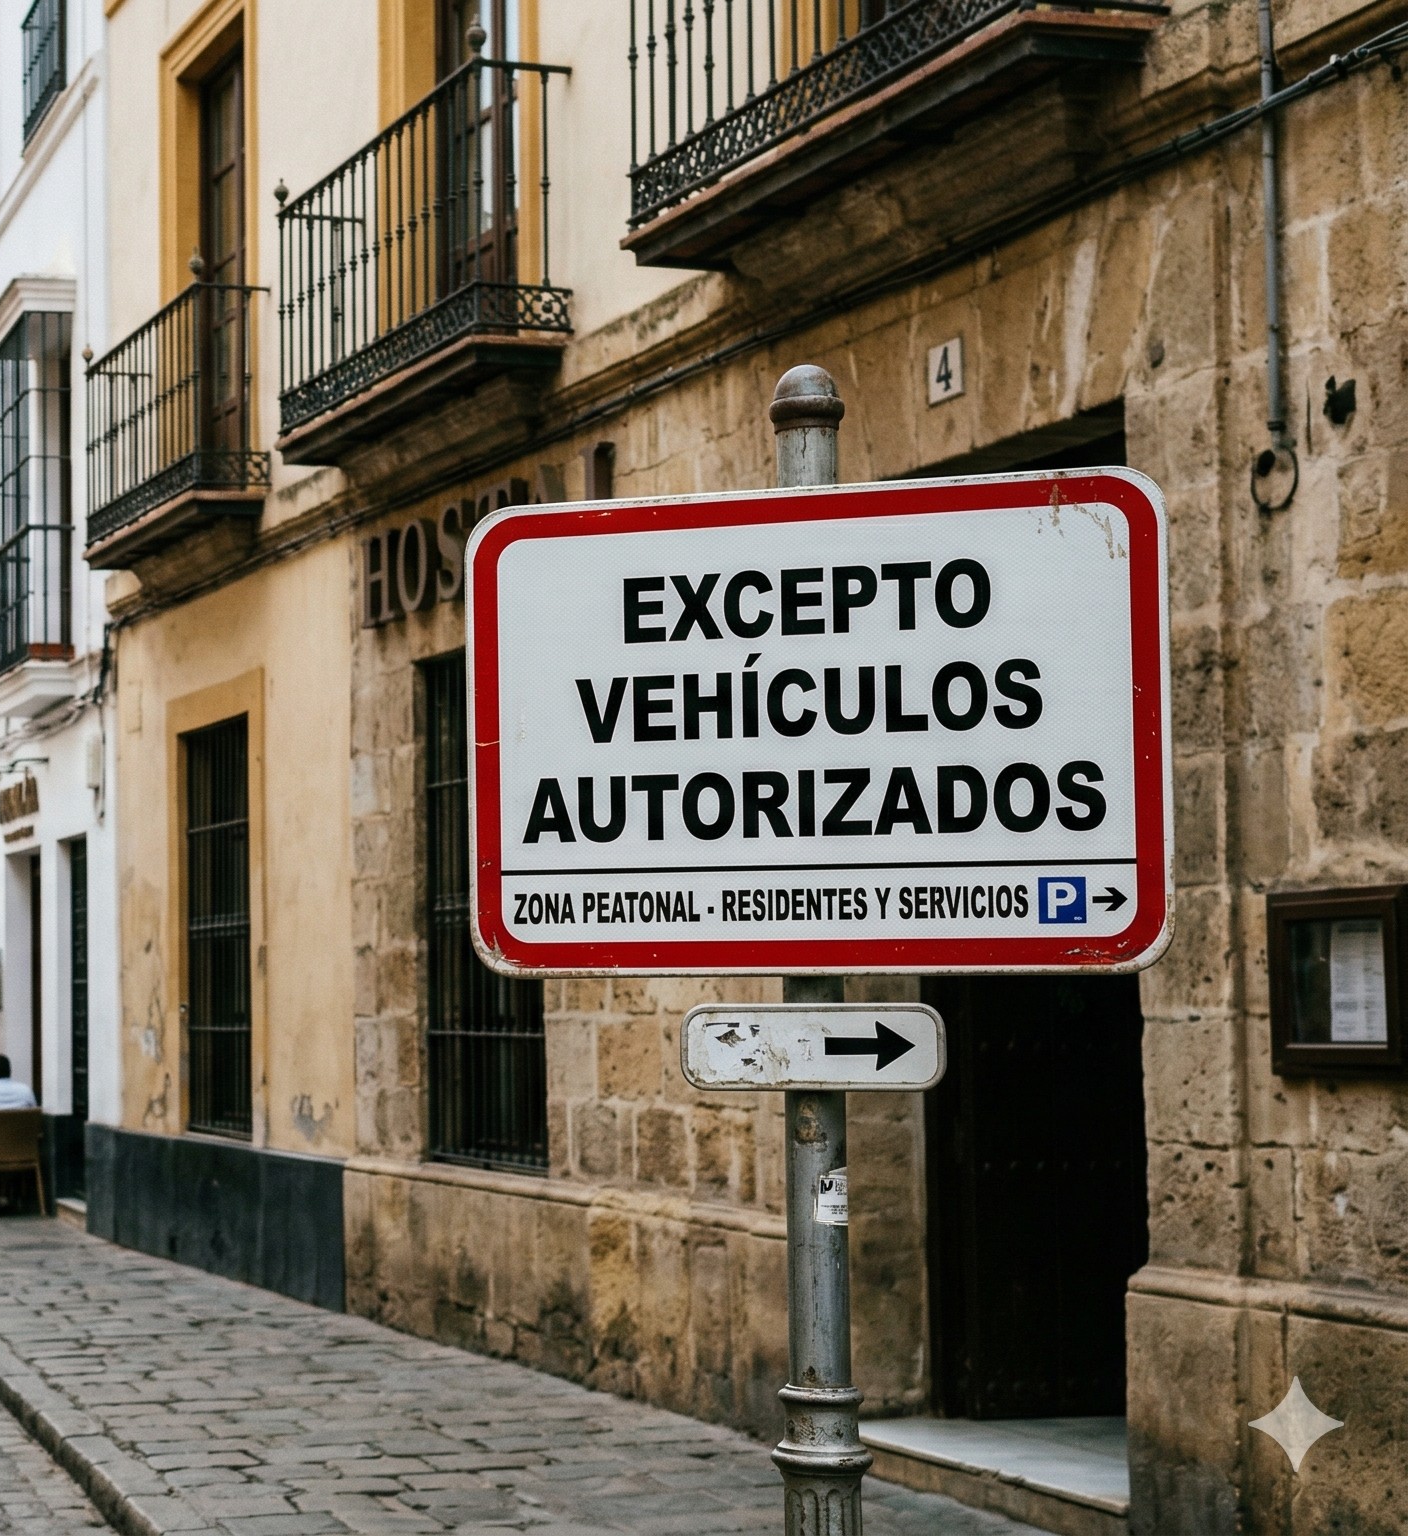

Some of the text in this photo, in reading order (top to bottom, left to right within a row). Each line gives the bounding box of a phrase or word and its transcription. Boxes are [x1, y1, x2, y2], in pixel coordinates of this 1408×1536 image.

[936, 346, 953, 392] 4
[622, 558, 991, 644] EXCEPTO
[575, 653, 1044, 744] VEHÍCULOS
[522, 760, 1107, 844] AUTORIZADOS
[513, 892, 576, 925] ZONA
[582, 890, 701, 924] PEATONAL
[721, 887, 868, 922] RESIDENTES
[874, 887, 892, 920] Y
[898, 884, 1029, 920] SERVICIOS
[1047, 882, 1077, 919] P
